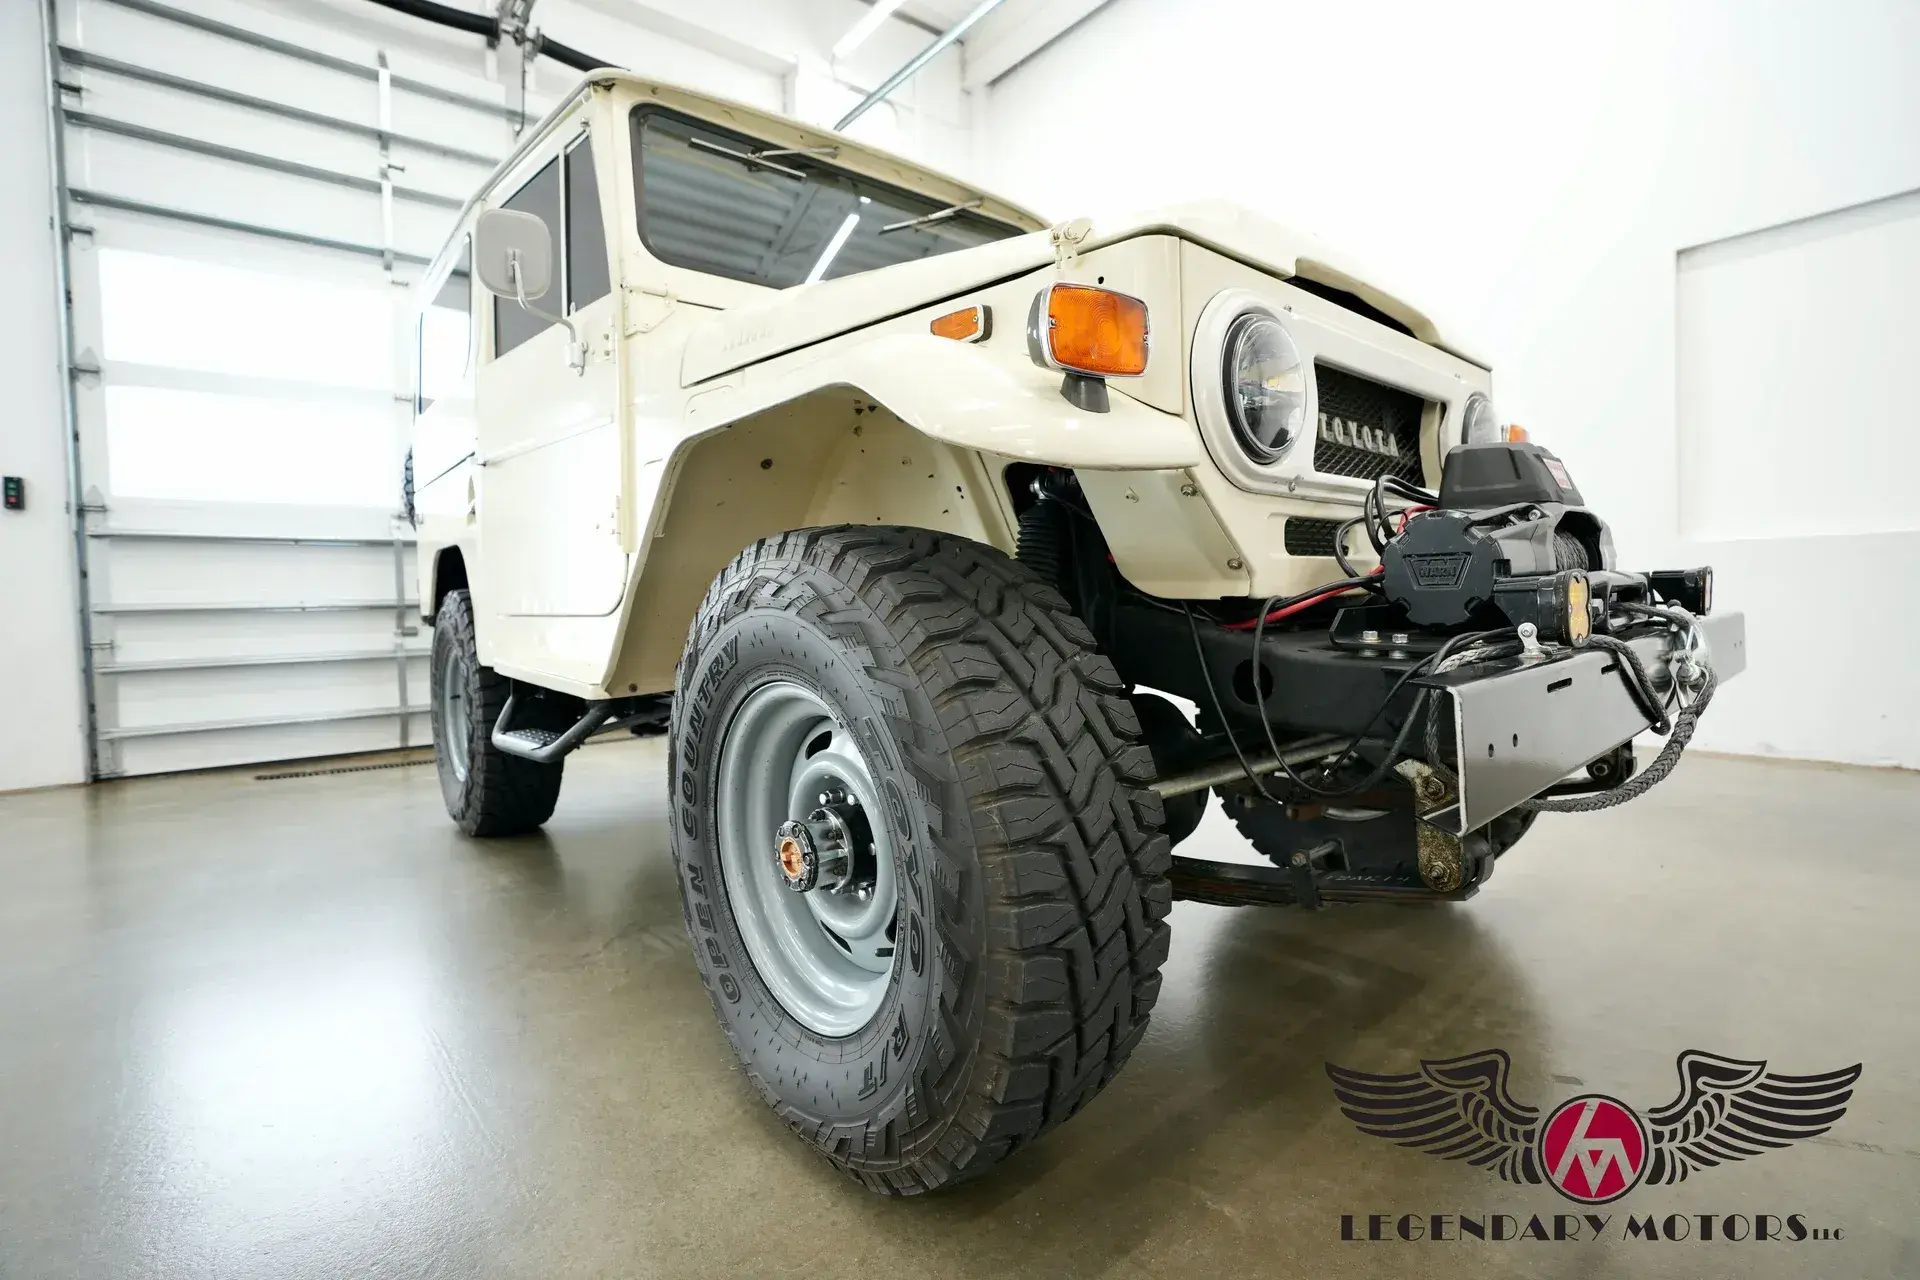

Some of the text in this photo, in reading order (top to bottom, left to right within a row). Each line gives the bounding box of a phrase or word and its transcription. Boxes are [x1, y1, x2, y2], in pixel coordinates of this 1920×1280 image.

[1318, 411, 1400, 457] TOYOTA
[1419, 566, 1457, 578] WARN
[681, 634, 742, 1005] OPEN COUNTRY
[864, 716, 924, 978] TOYO
